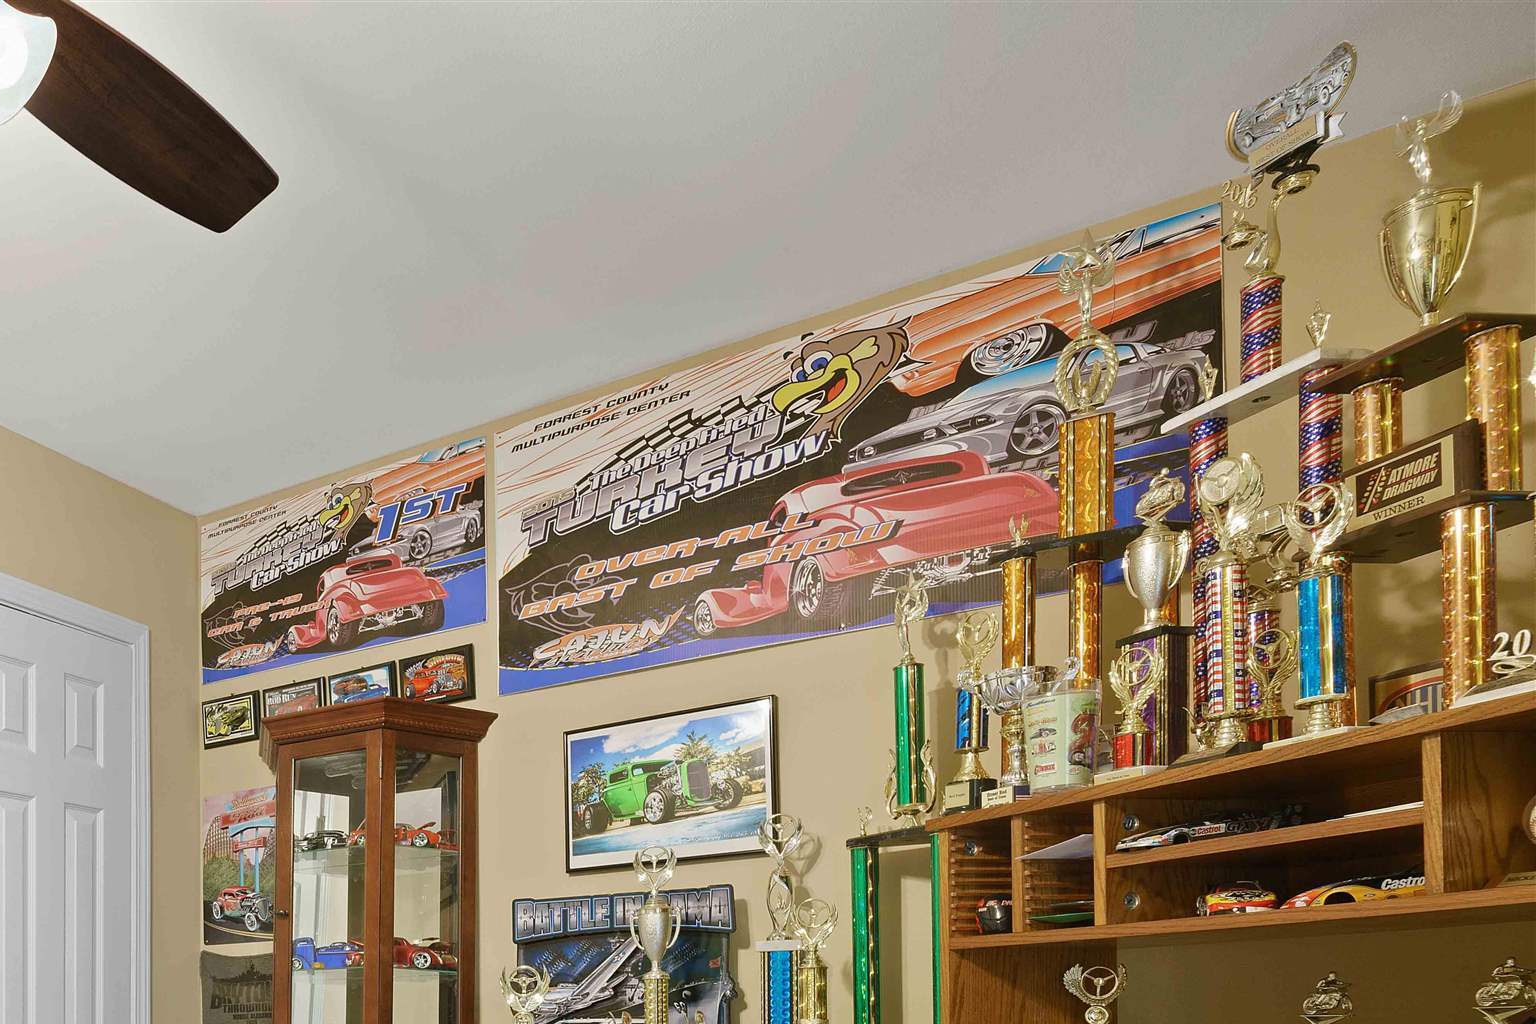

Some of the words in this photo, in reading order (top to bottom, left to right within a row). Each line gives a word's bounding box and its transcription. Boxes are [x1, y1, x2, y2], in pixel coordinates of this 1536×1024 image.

[511, 412, 621, 453] MULTIPURPOSE
[625, 389, 692, 416] CENTER
[533, 405, 603, 433] FORREST
[605, 382, 670, 410] COUNTY
[522, 418, 784, 547] TURKEY
[1382, 468, 1439, 501] DRAGWAY
[1387, 451, 1440, 485] ATMORE
[207, 520, 258, 539] MULTIPURPOSE
[259, 511, 288, 522] CENTER
[217, 513, 249, 528] FORREST
[250, 505, 279, 519] COUNTY
[375, 482, 467, 544] 1ST
[1372, 495, 1425, 521] WINNER
[212, 527, 324, 595] TURKEY
[649, 560, 720, 589] OF
[732, 520, 902, 571] SHOW
[269, 599, 331, 622] TRUCK
[1197, 824, 1223, 835] Castrol
[1380, 875, 1426, 891] Castro
[516, 896, 611, 940] BATTLE
